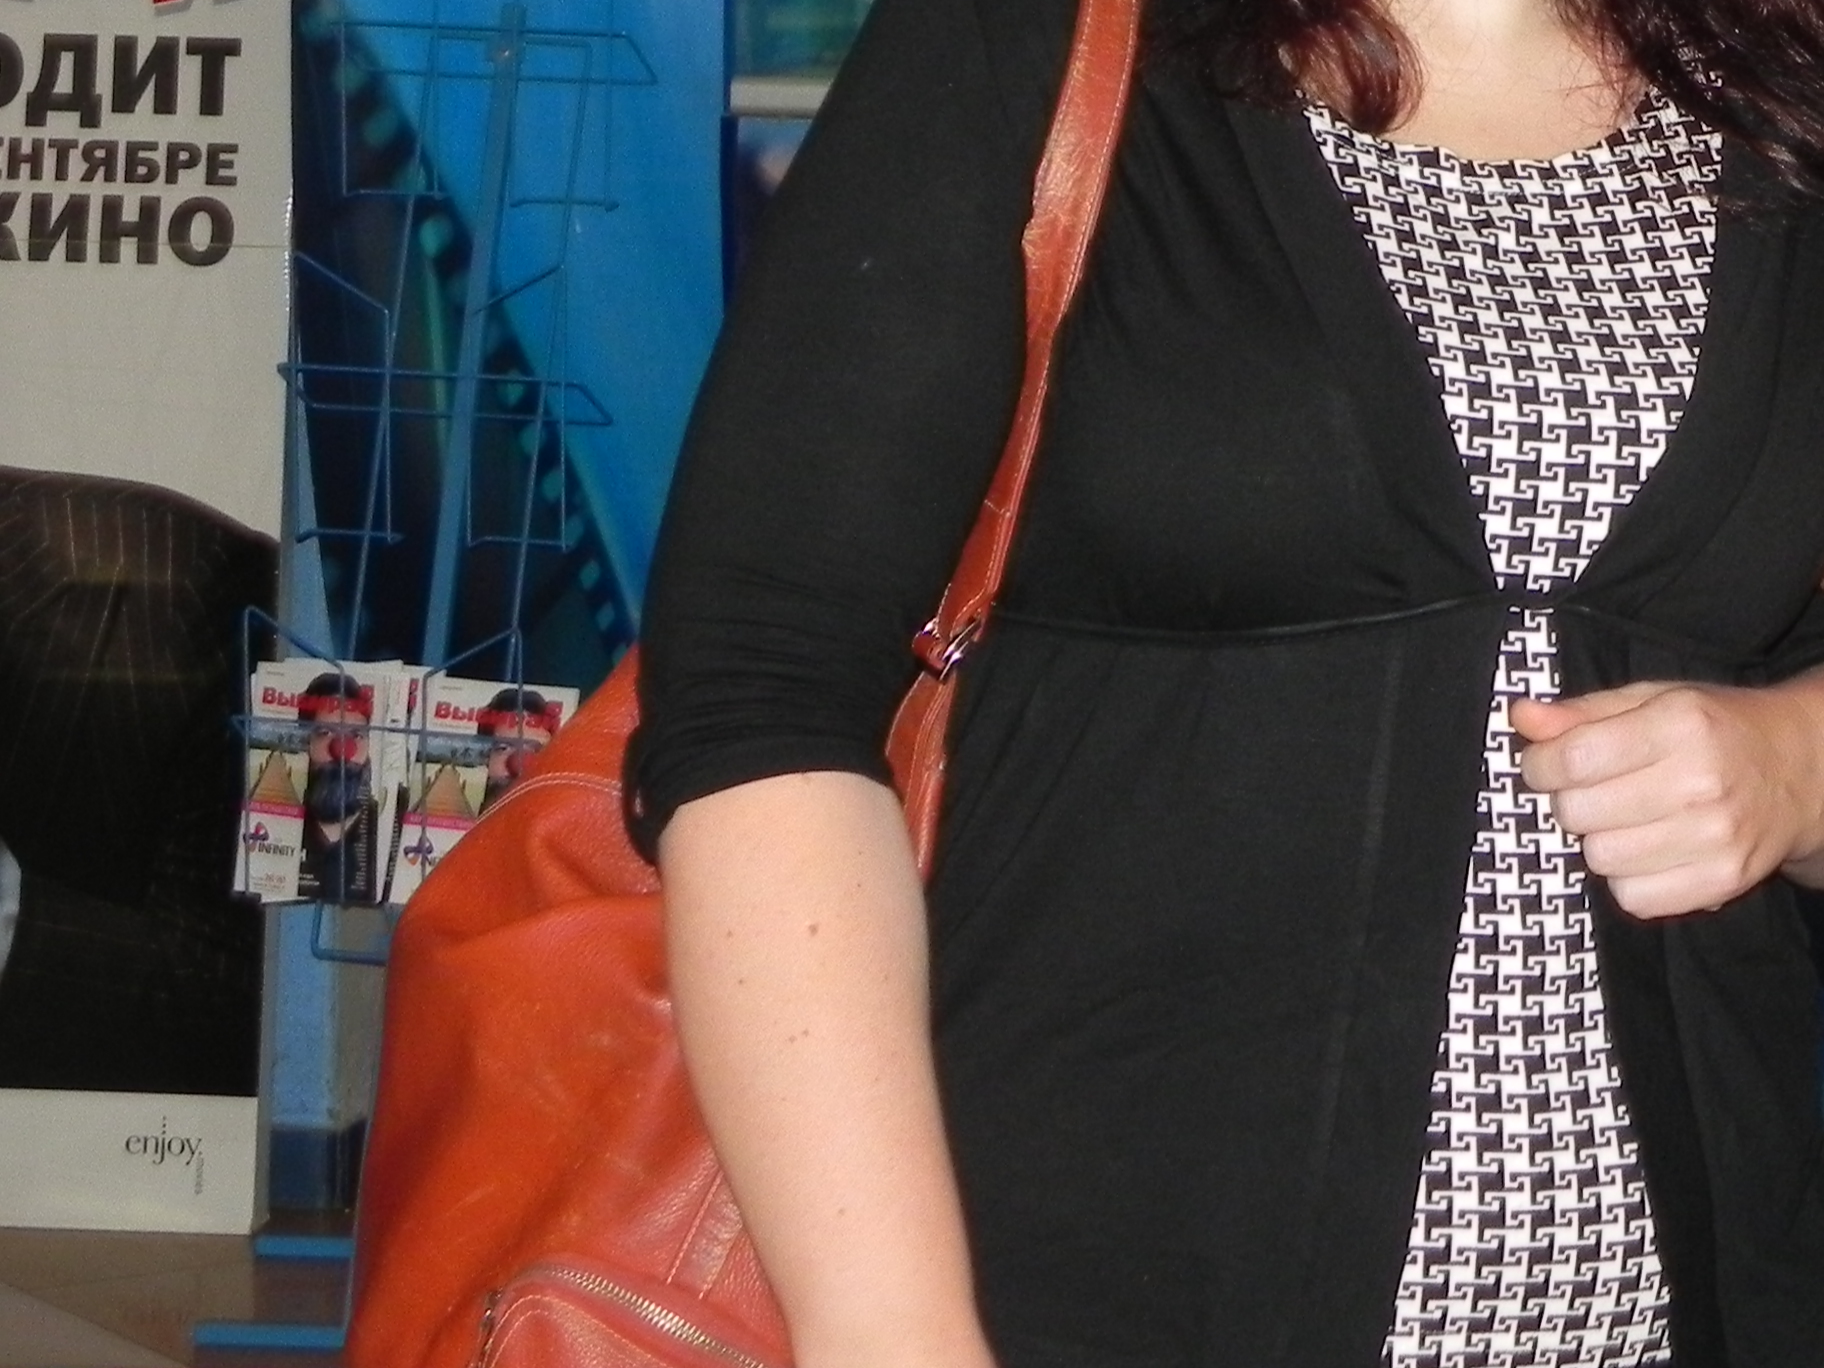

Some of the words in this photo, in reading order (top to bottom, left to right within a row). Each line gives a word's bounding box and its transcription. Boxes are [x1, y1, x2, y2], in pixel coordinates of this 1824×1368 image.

[0, 137, 239, 186] НТЯБРЕ
[257, 842, 297, 858] INFINITY
[125, 1116, 202, 1166] enjoy
